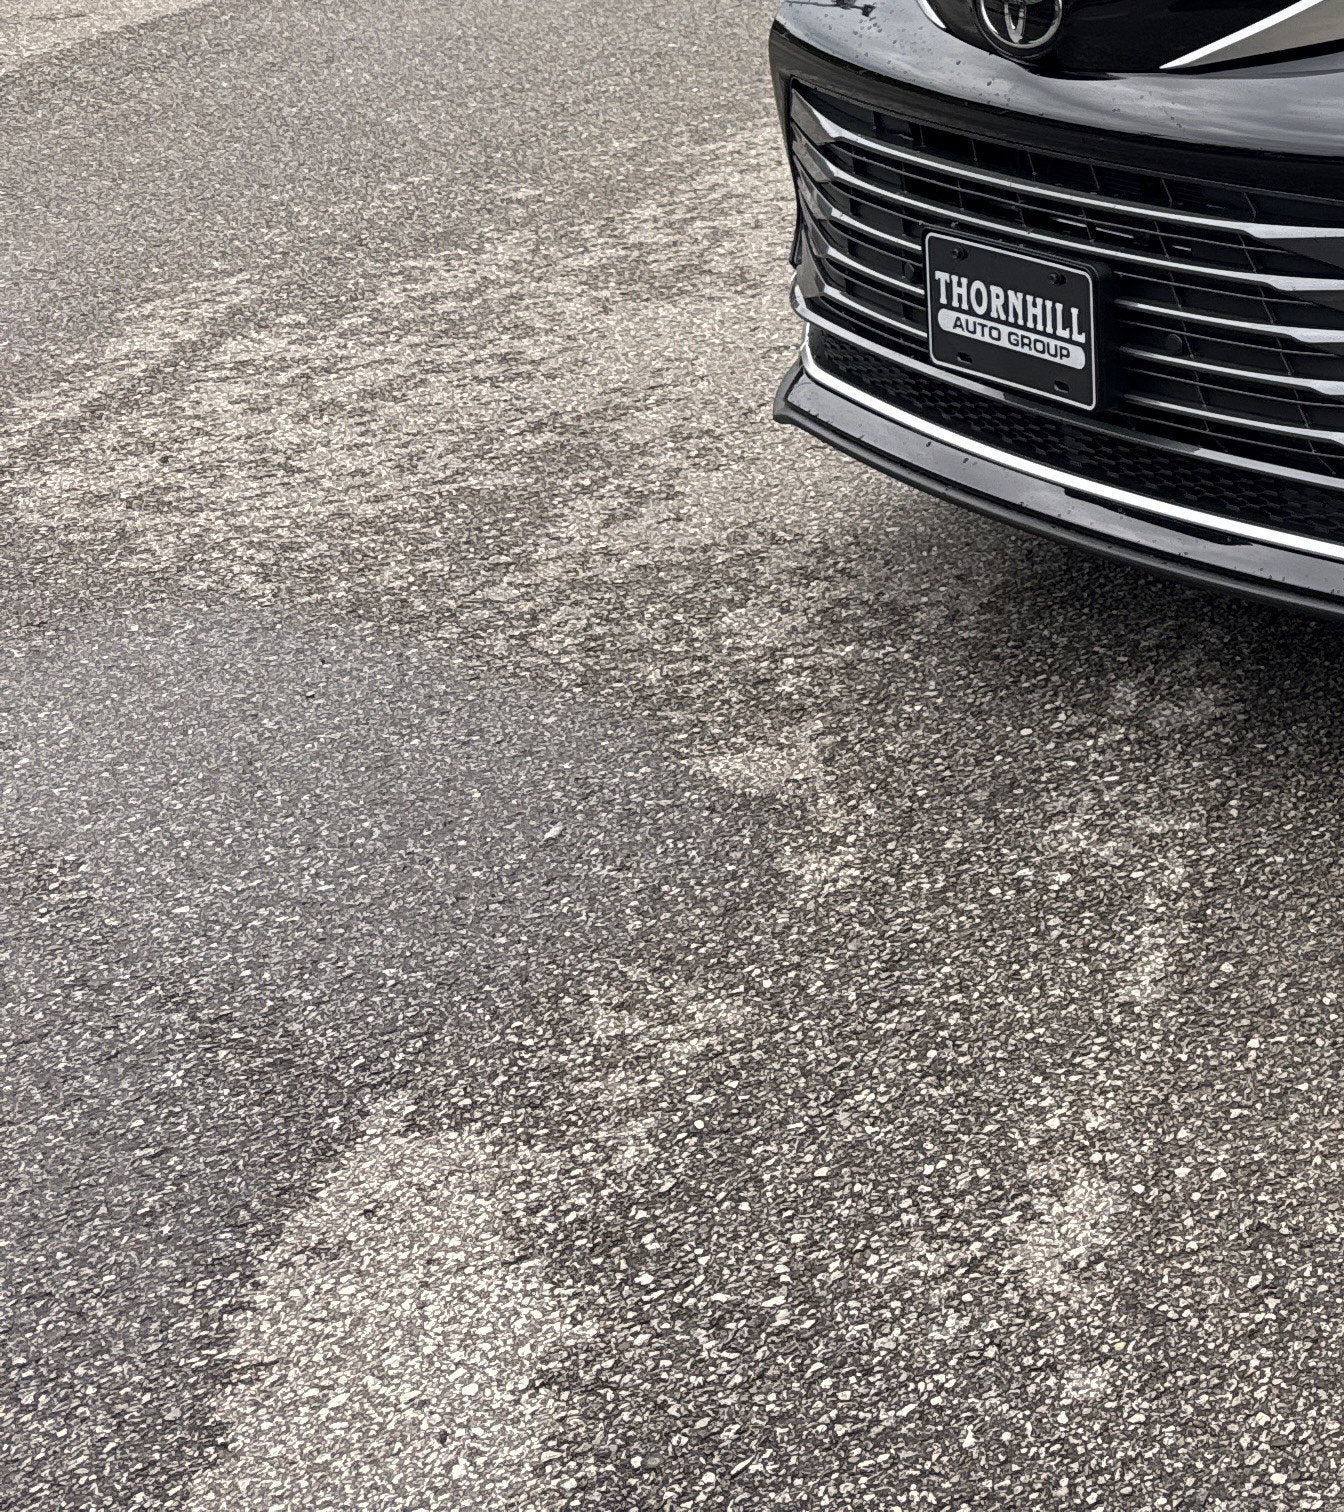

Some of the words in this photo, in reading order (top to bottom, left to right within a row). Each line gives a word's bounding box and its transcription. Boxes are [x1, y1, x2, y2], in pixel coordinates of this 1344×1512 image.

[934, 270, 1086, 344] THORNHILL
[952, 316, 1002, 342] AUTO
[1007, 331, 1071, 361] GROUP
